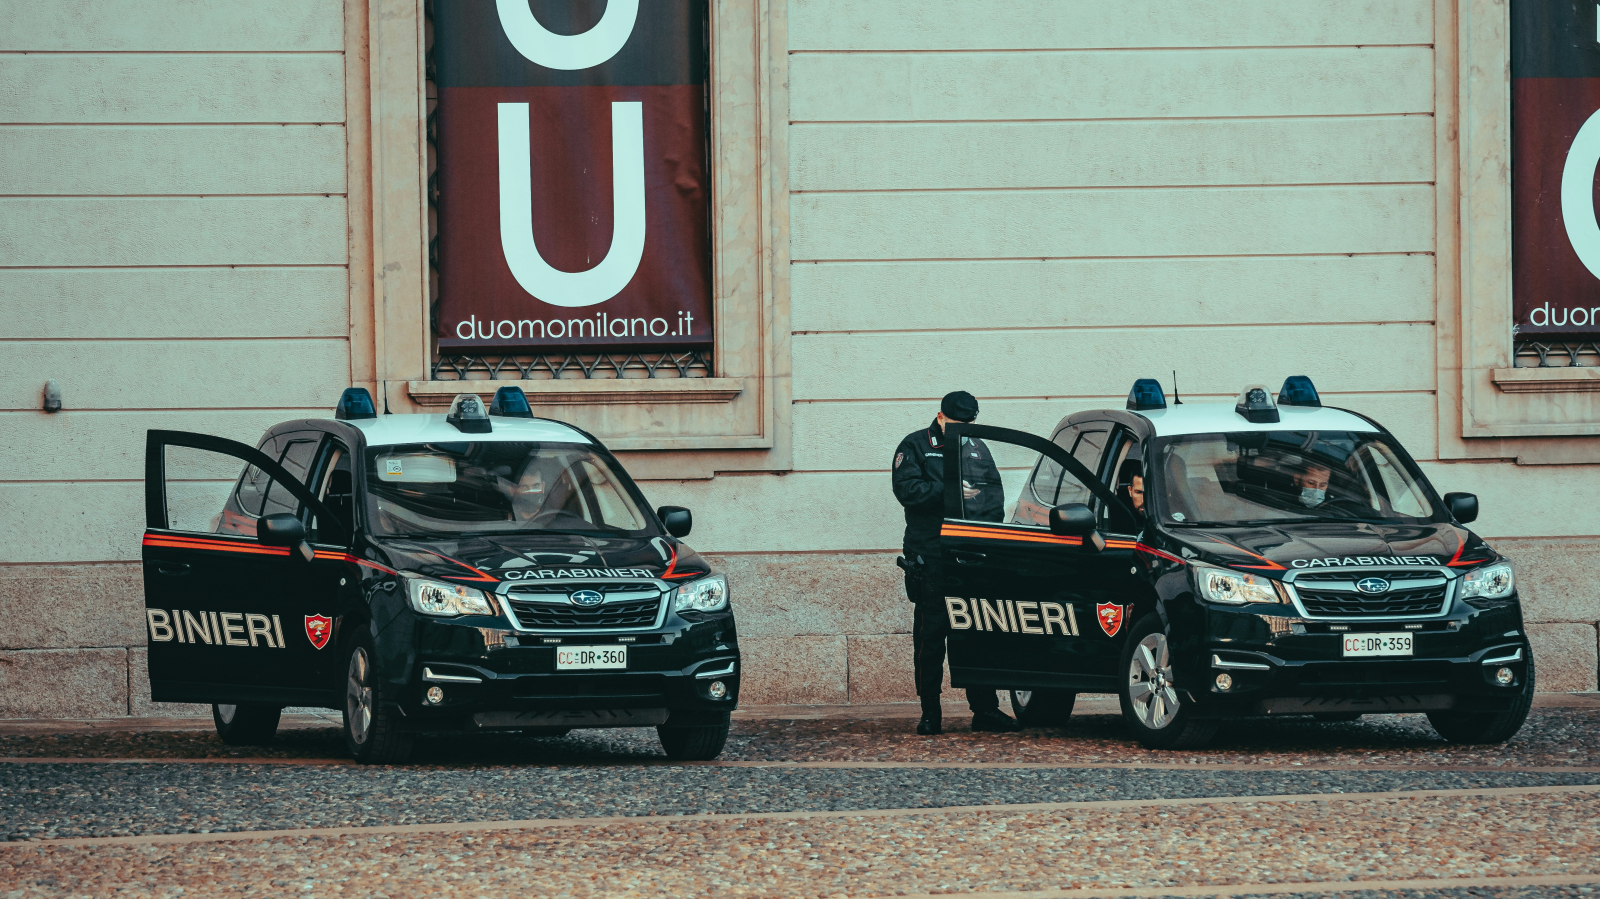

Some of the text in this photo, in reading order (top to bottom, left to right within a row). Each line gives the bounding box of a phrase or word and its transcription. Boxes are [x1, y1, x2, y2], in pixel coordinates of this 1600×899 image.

[456, 310, 694, 339] duomomilano.it
[504, 568, 655, 580] CARABINIERI
[1291, 556, 1441, 568] CARABINIERI
[146, 608, 286, 649] BINIERI
[944, 596, 1080, 636] BINIERI
